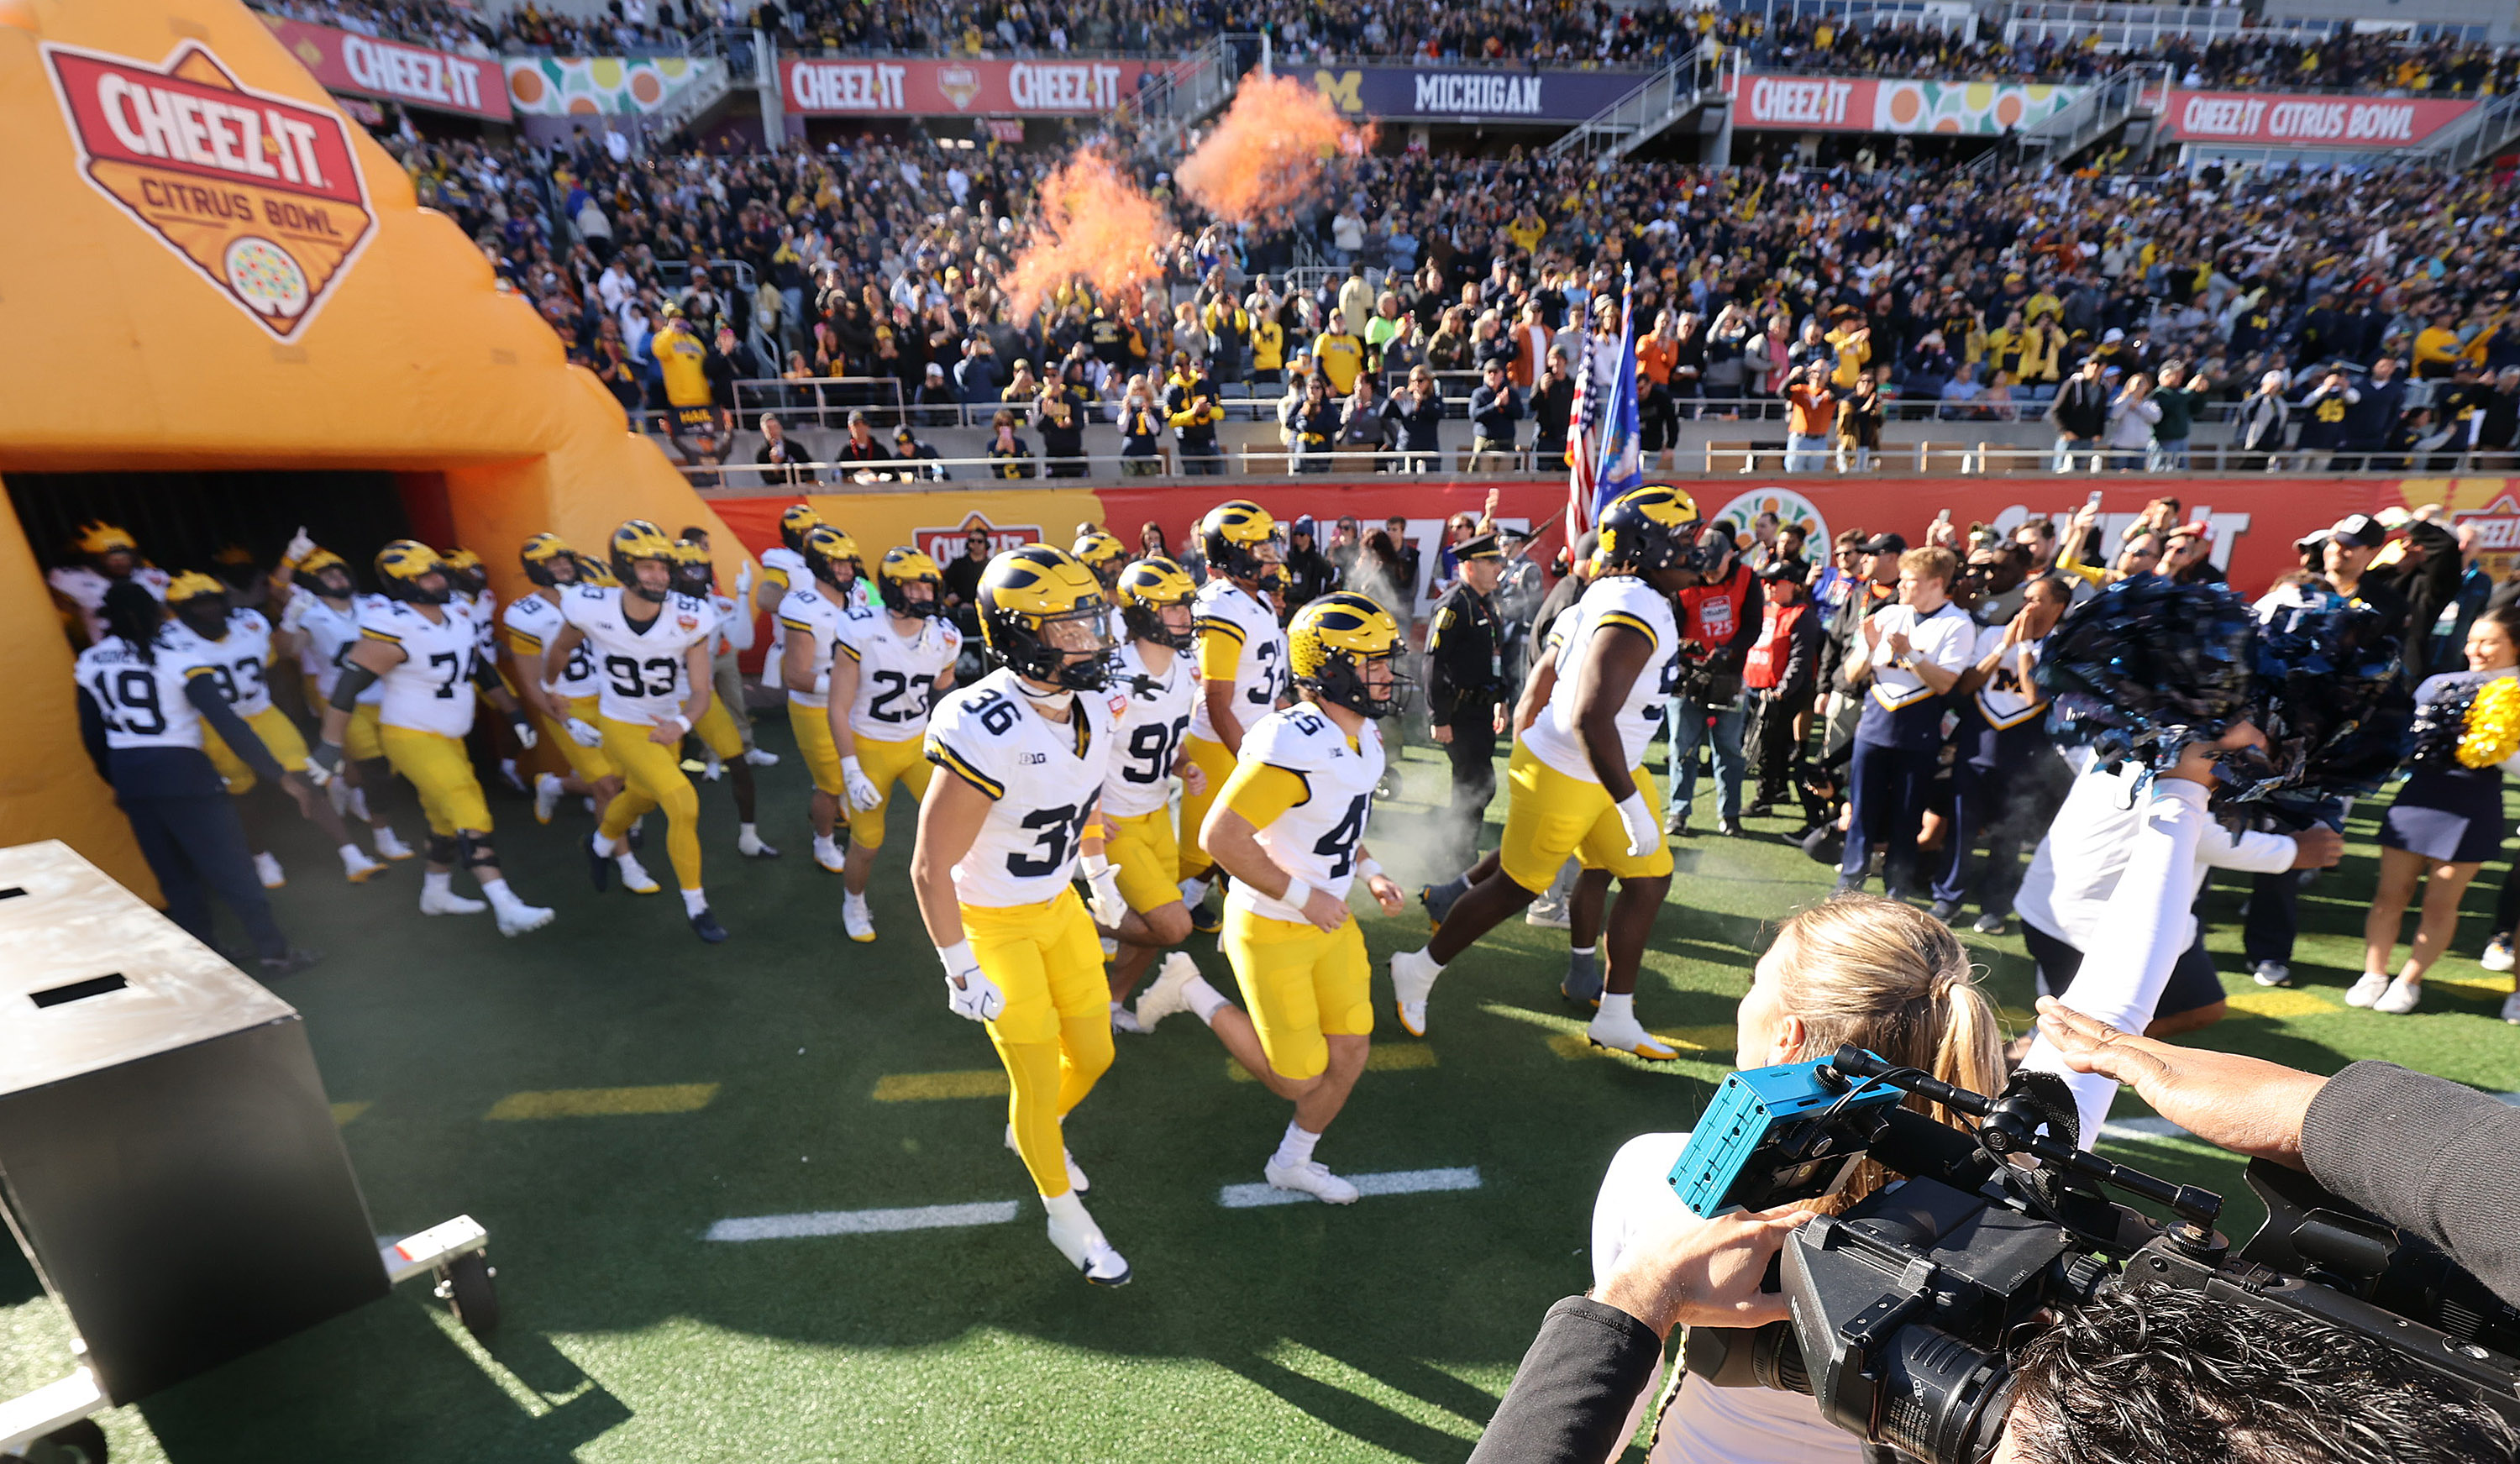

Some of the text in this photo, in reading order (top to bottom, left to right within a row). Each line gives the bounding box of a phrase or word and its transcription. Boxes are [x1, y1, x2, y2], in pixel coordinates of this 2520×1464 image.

[1314, 70, 1363, 113] M
[1414, 73, 1542, 114] MICHIGAN
[2269, 101, 2348, 139] CITRUS
[2346, 103, 2415, 140] BOWL
[139, 177, 341, 237] CITRUS BOWL
[1703, 620, 1734, 637] 125
[606, 654, 677, 698] 93
[869, 669, 935, 723] 23
[94, 669, 166, 735] 19
[960, 688, 1021, 736] 36
